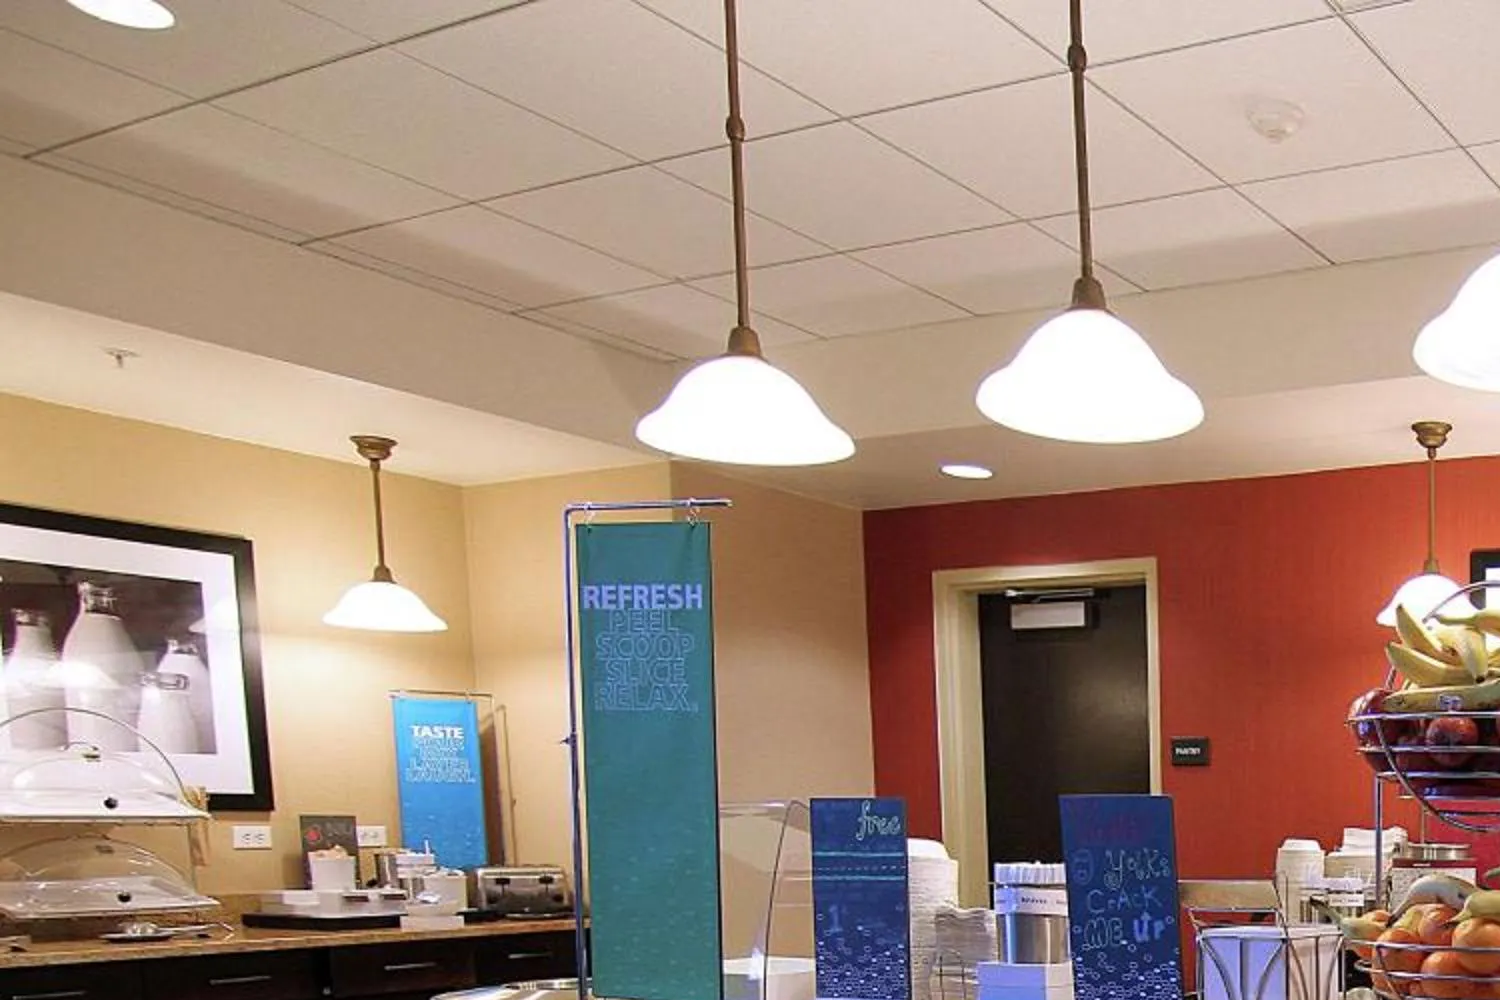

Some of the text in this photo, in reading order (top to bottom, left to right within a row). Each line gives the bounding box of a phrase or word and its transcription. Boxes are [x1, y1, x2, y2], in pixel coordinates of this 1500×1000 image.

[583, 584, 703, 609] REFRESH
[609, 608, 680, 633] PEEL
[595, 632, 695, 660] SCOOP
[605, 658, 685, 685] SLICE
[411, 725, 465, 739] TASTE
